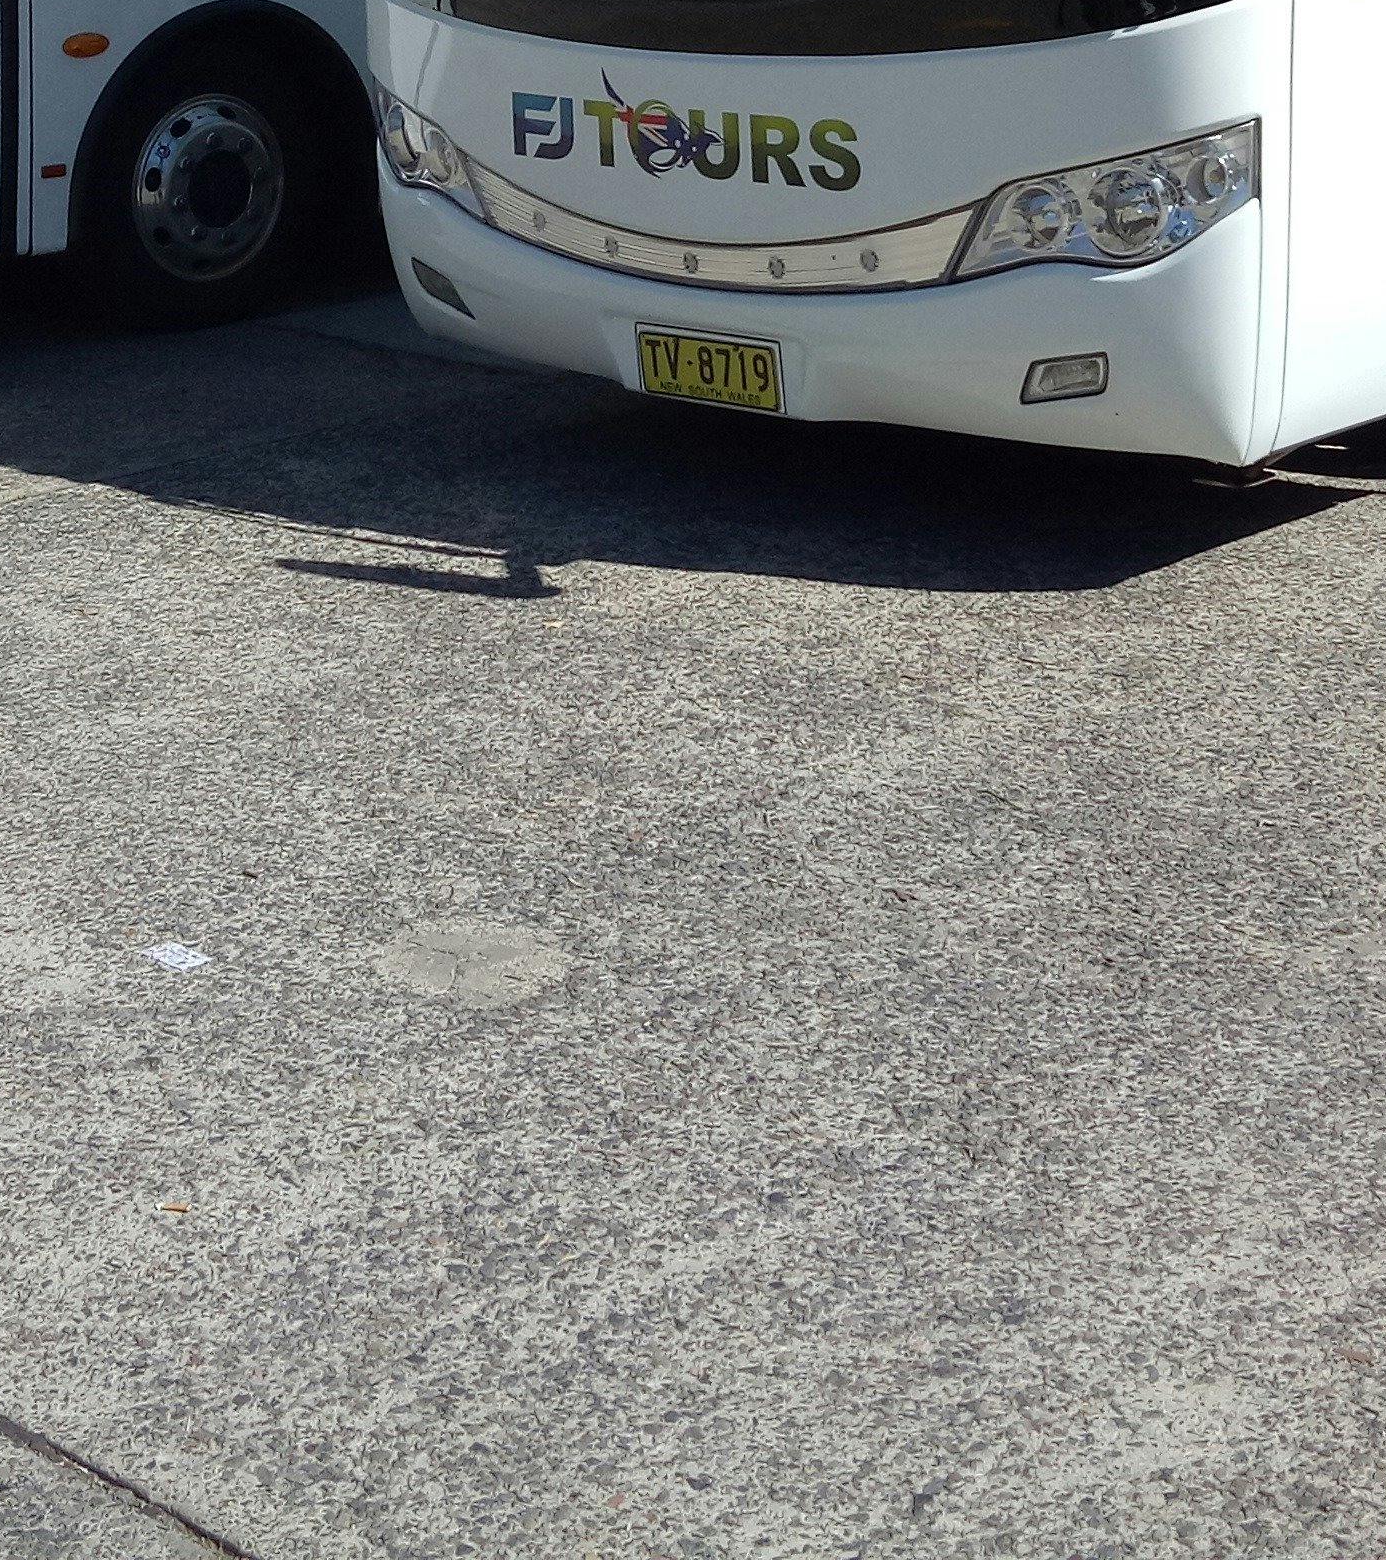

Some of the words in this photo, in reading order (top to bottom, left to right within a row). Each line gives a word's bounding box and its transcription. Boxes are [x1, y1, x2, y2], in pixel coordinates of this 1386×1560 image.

[511, 90, 576, 160] FJ
[582, 97, 863, 192] TOURS
[659, 380, 683, 393] NEW
[688, 384, 723, 398] SOUTH
[728, 390, 761, 406] WALES
